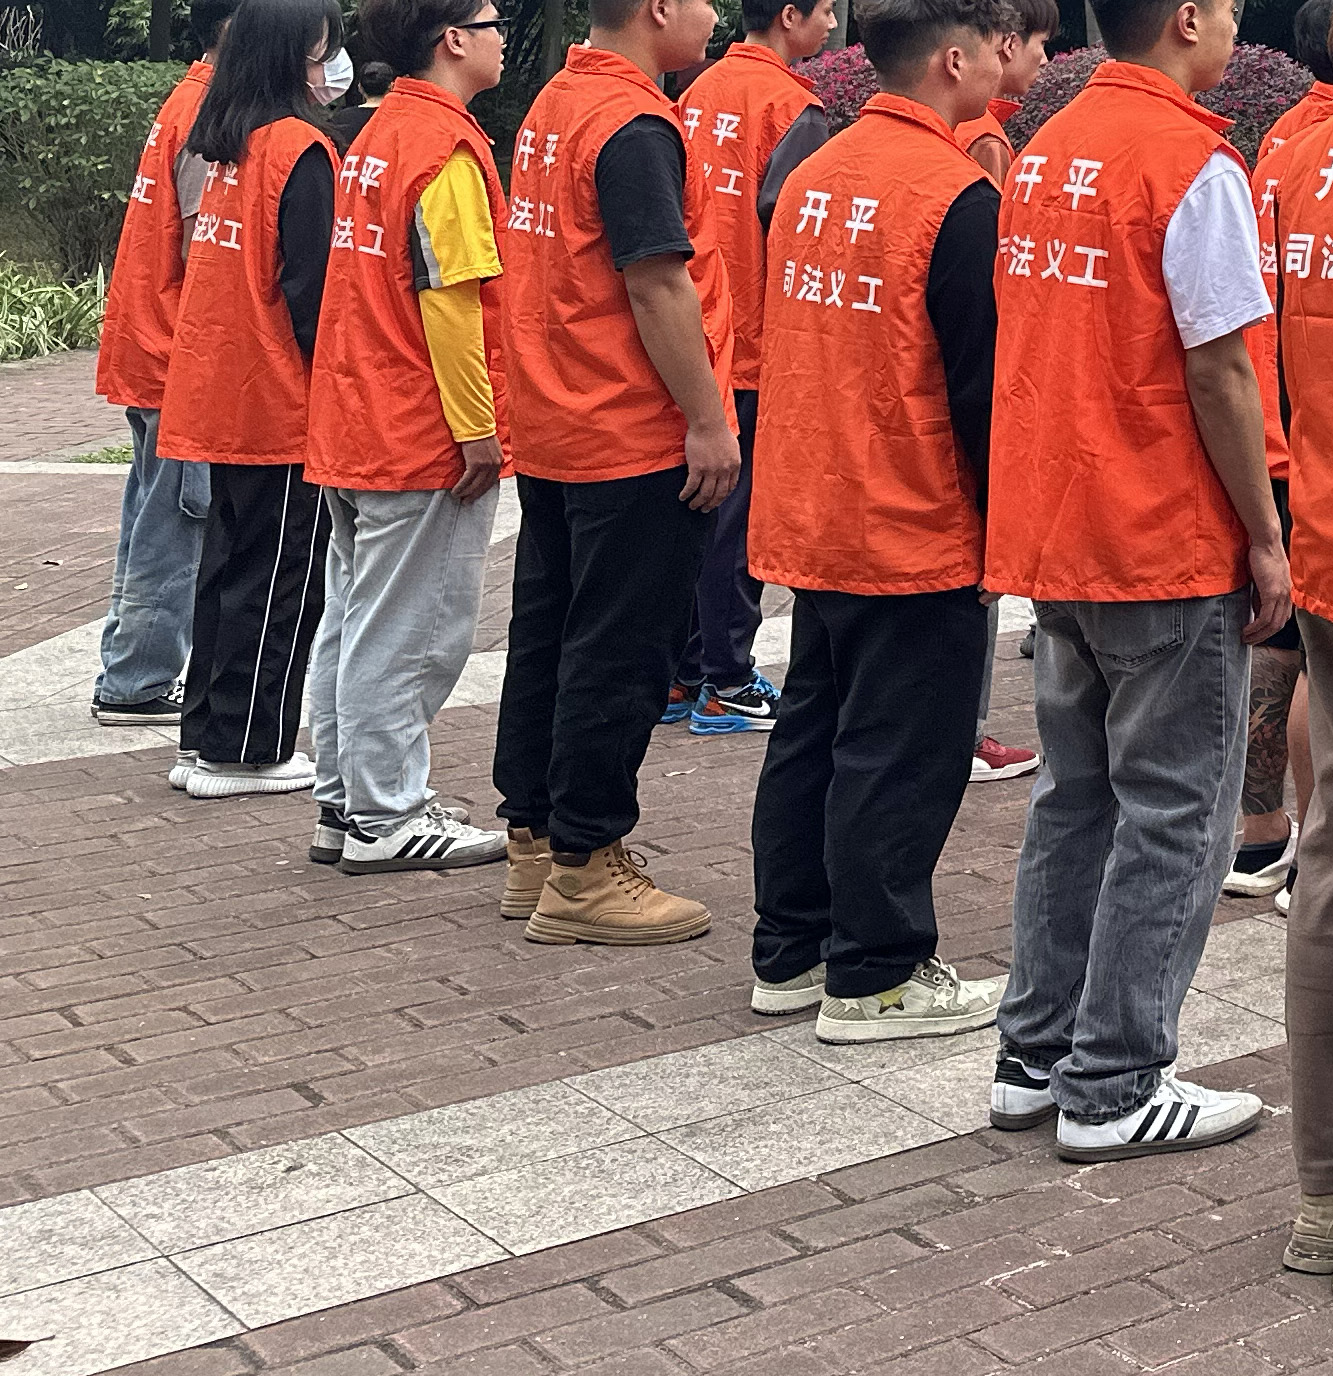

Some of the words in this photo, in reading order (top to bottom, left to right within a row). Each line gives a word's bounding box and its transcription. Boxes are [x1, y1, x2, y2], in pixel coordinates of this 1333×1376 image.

[339, 155, 389, 197] 开平
[516, 128, 560, 176] 开平
[1012, 155, 1104, 210] 开平
[795, 189, 880, 244] 开平
[783, 260, 884, 314] 司法义工
